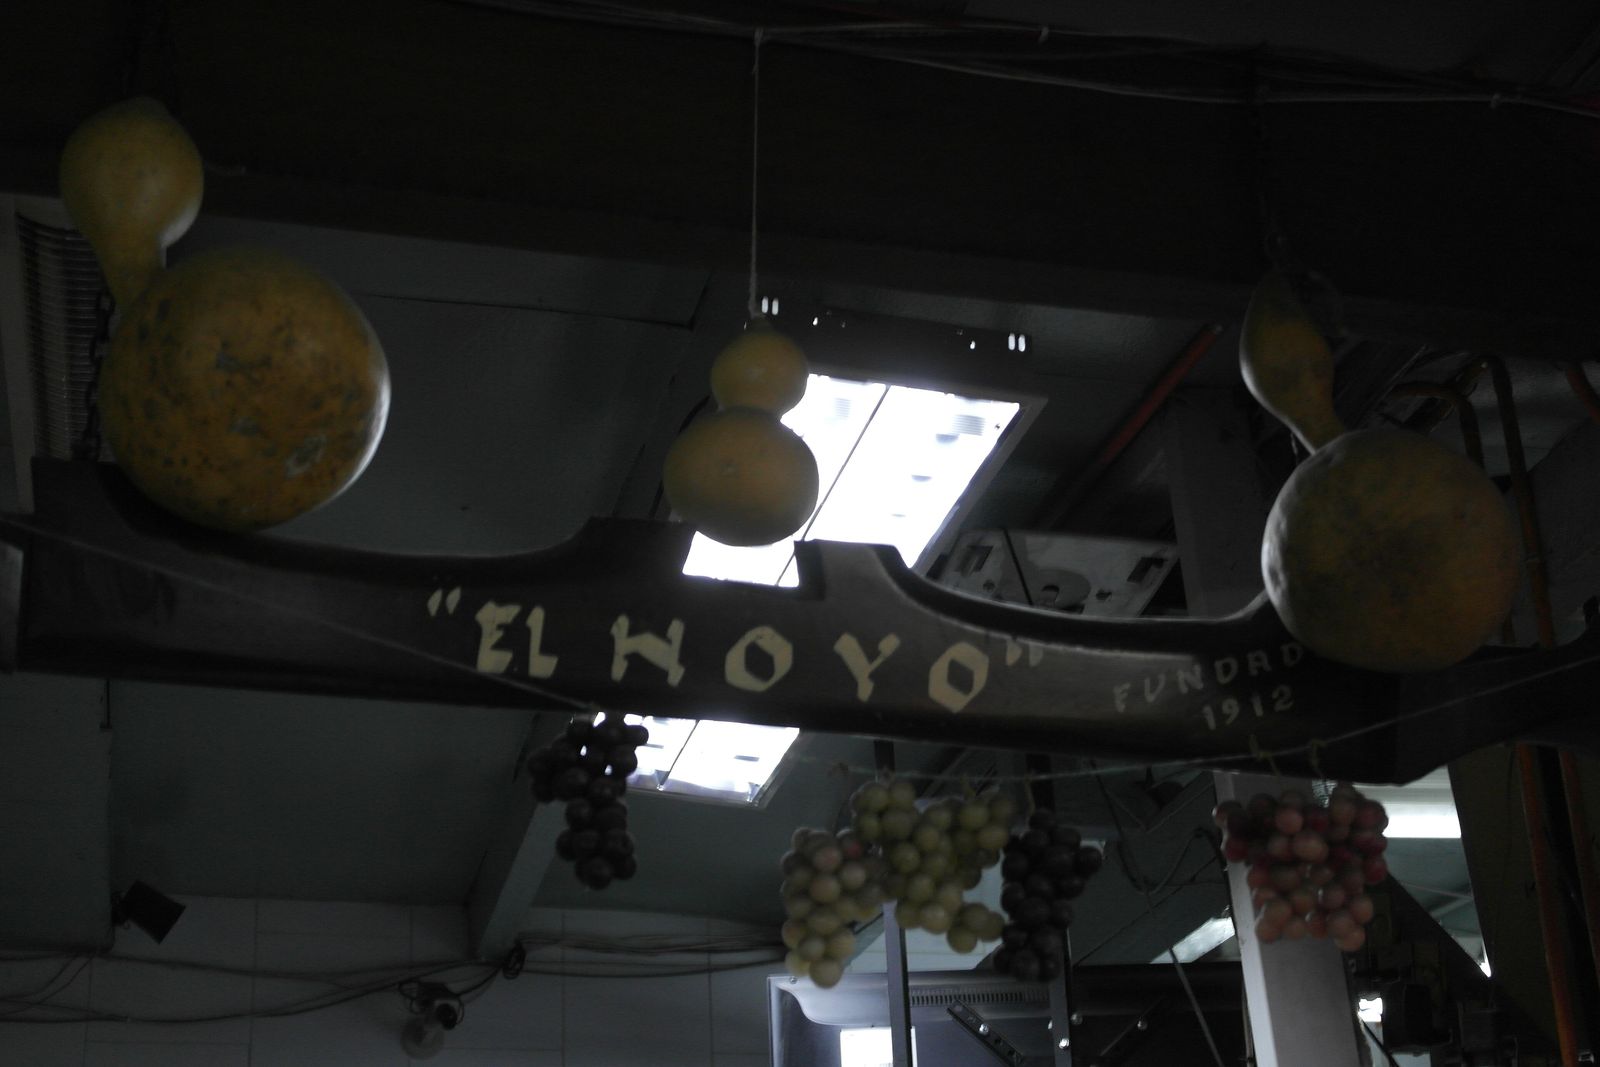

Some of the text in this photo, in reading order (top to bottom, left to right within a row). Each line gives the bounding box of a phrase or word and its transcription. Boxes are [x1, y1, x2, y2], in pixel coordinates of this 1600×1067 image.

[427, 586, 559, 679] "EL
[1113, 641, 1303, 713] FUNDAD
[1202, 684, 1294, 730] 1912
